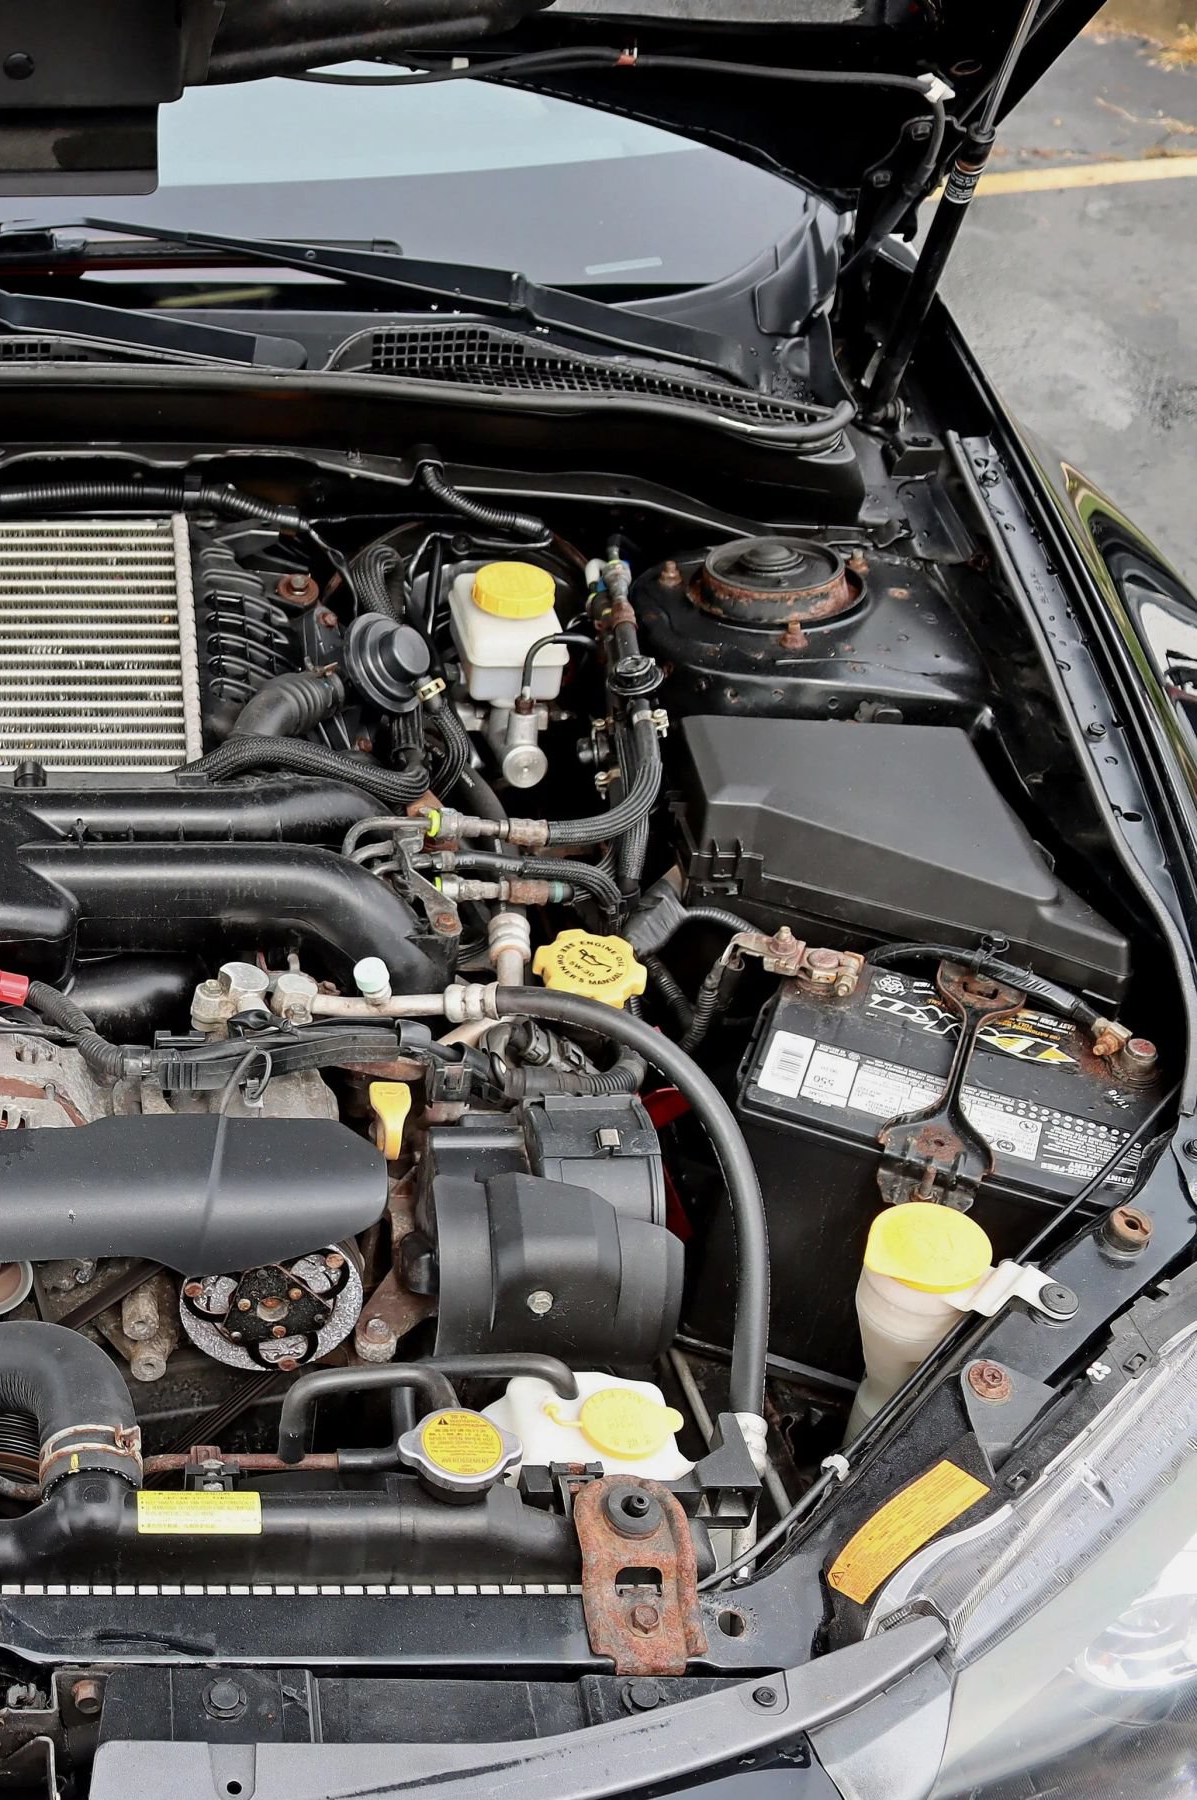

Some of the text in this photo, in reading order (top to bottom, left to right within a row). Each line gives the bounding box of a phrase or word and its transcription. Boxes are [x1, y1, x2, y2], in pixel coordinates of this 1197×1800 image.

[580, 940, 626, 967] ENGINE OIL
[588, 971, 623, 985] MANUAL
